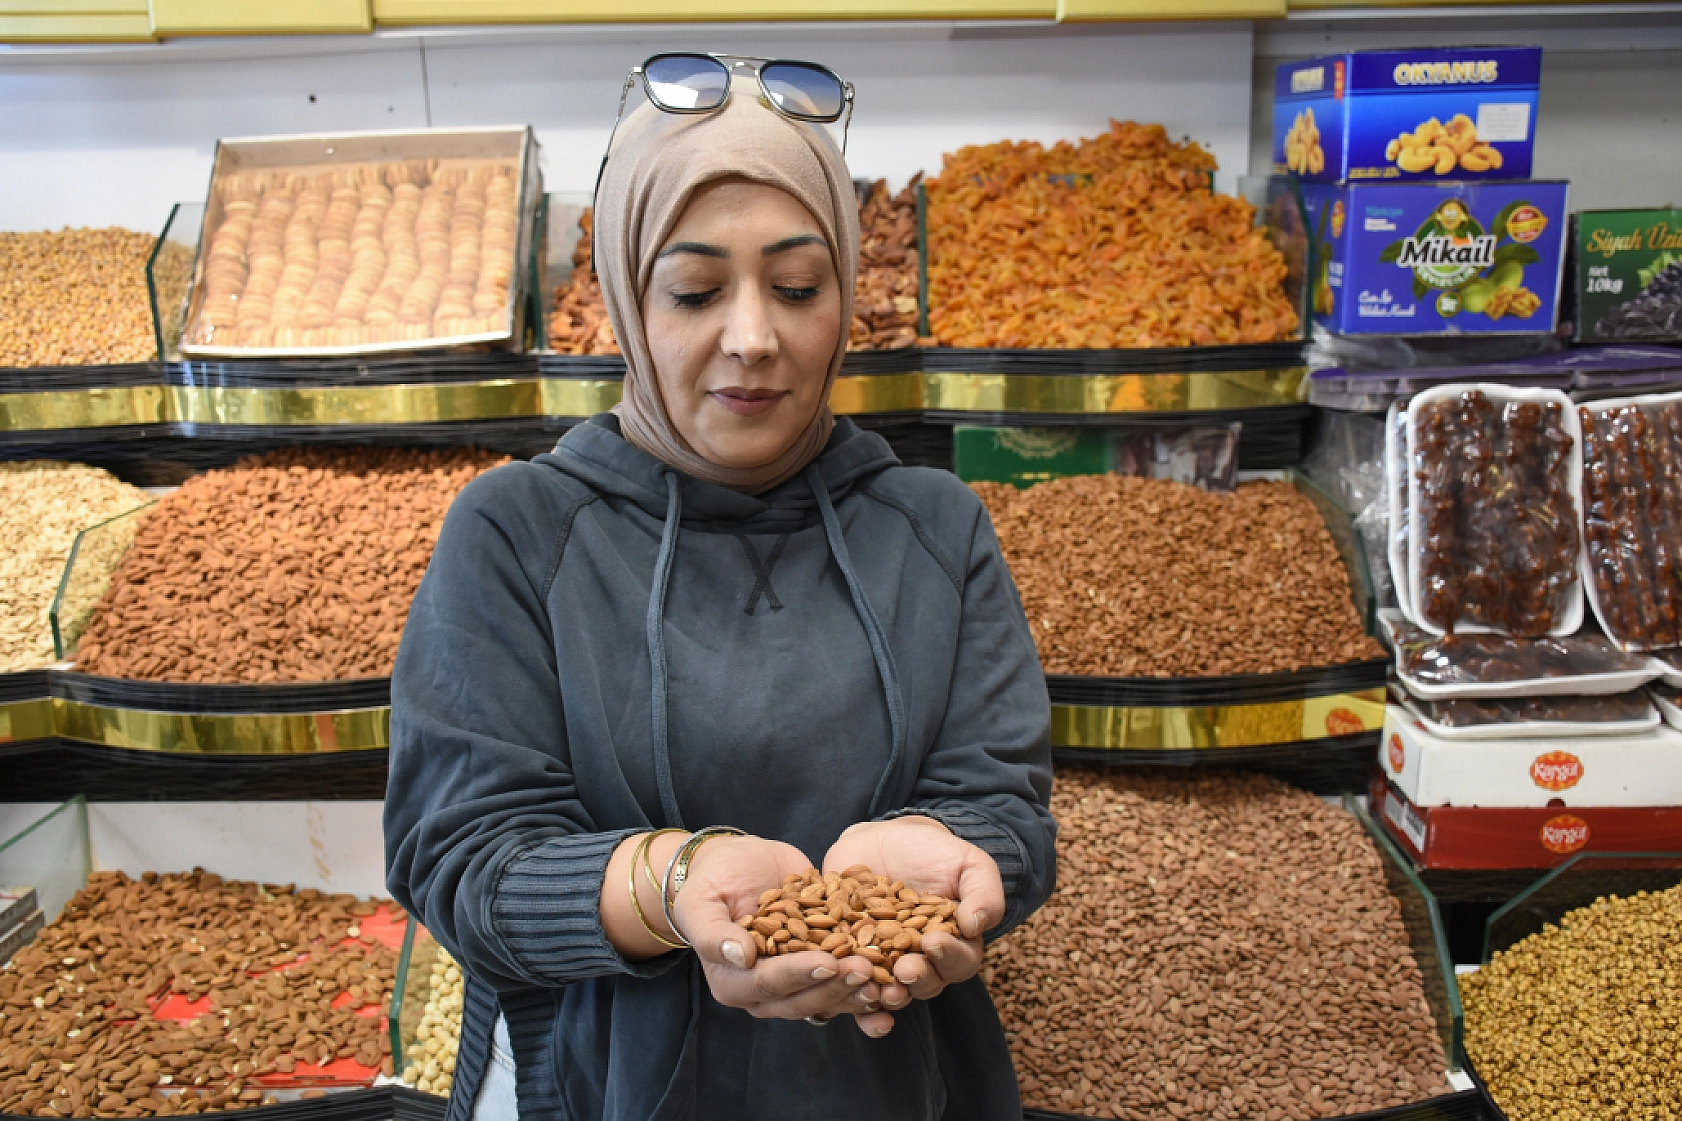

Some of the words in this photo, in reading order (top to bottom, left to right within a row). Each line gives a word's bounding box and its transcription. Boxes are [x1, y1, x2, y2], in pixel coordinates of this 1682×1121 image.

[1393, 61, 1498, 85] OKYANUS
[1397, 236, 1498, 268] Mikail
[1586, 227, 1642, 258] Siyah
